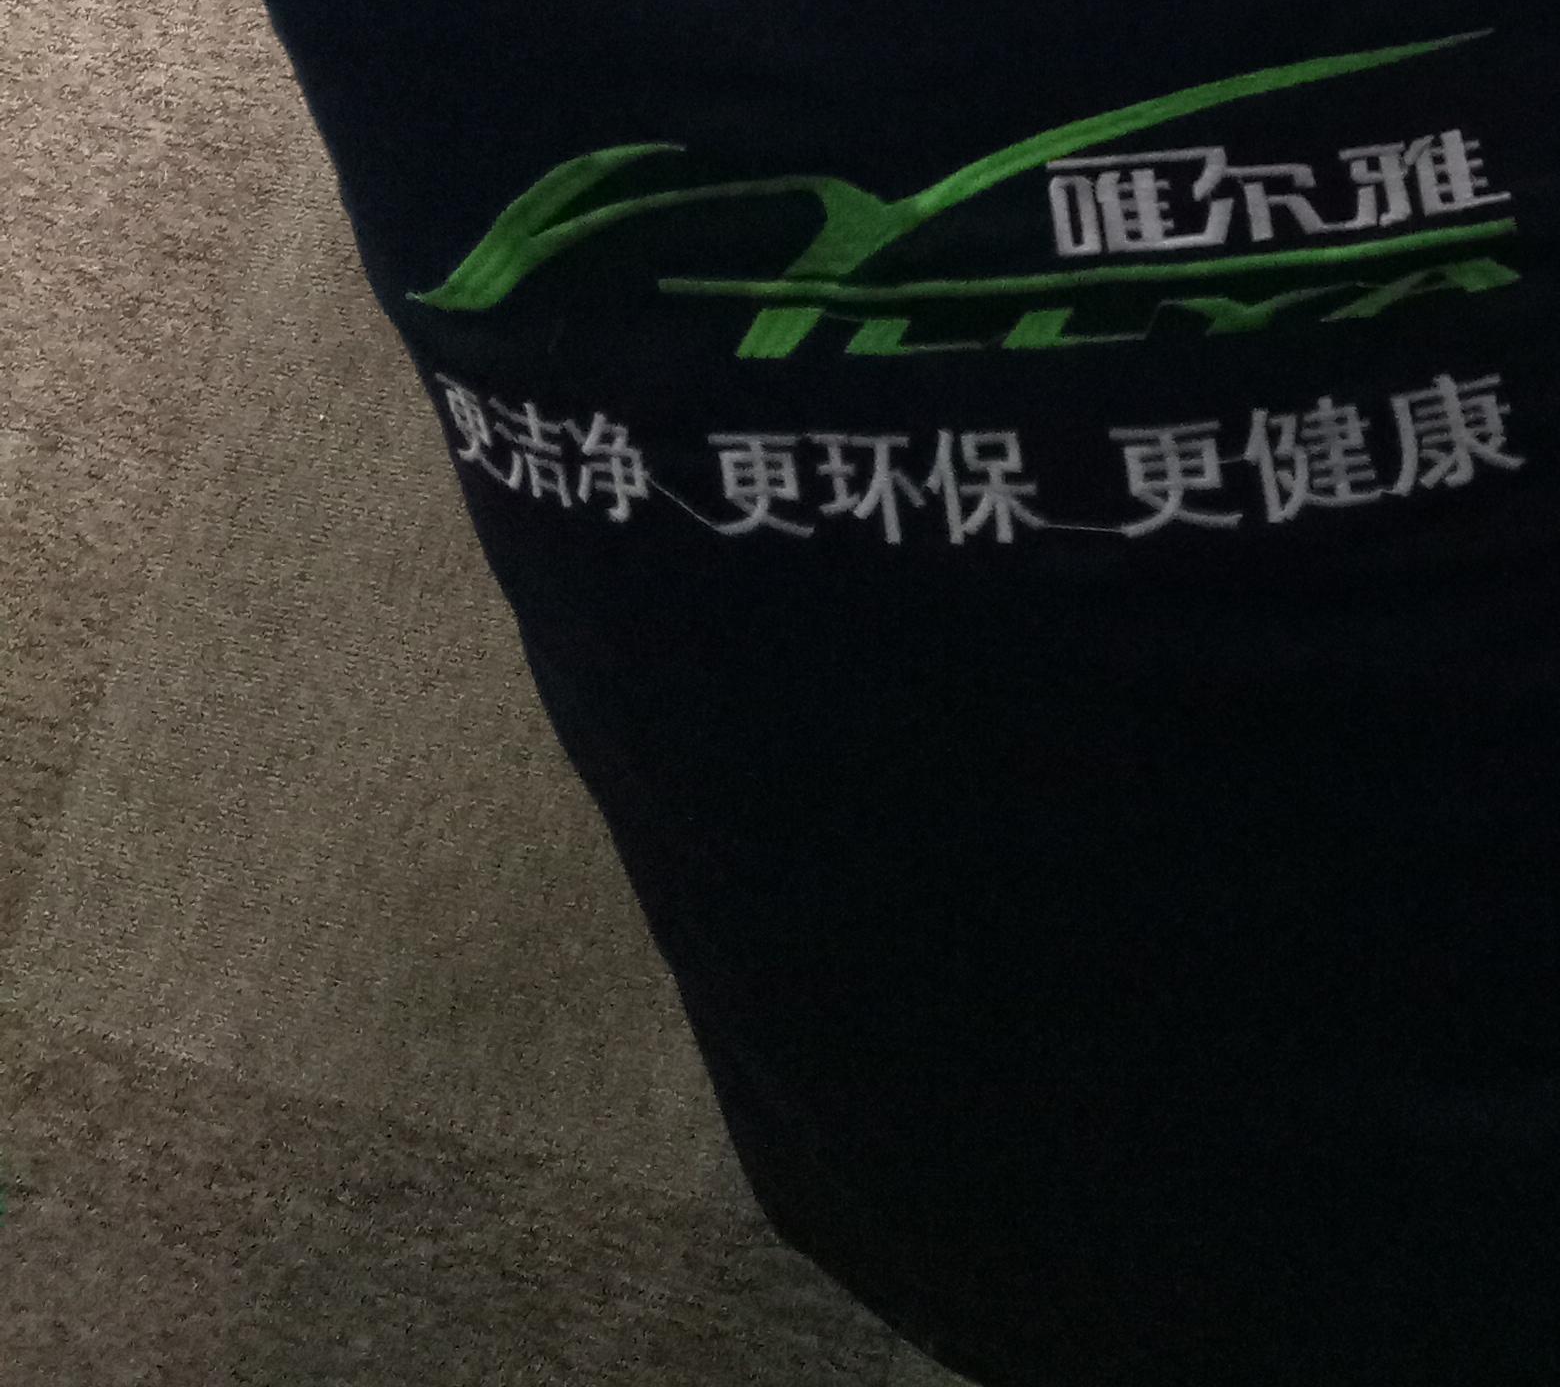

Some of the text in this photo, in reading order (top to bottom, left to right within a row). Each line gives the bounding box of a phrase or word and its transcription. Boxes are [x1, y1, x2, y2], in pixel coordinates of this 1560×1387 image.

[1046, 128, 1513, 256] 唯尔雅
[434, 372, 1525, 544] 更洁净 更环保 更健康
